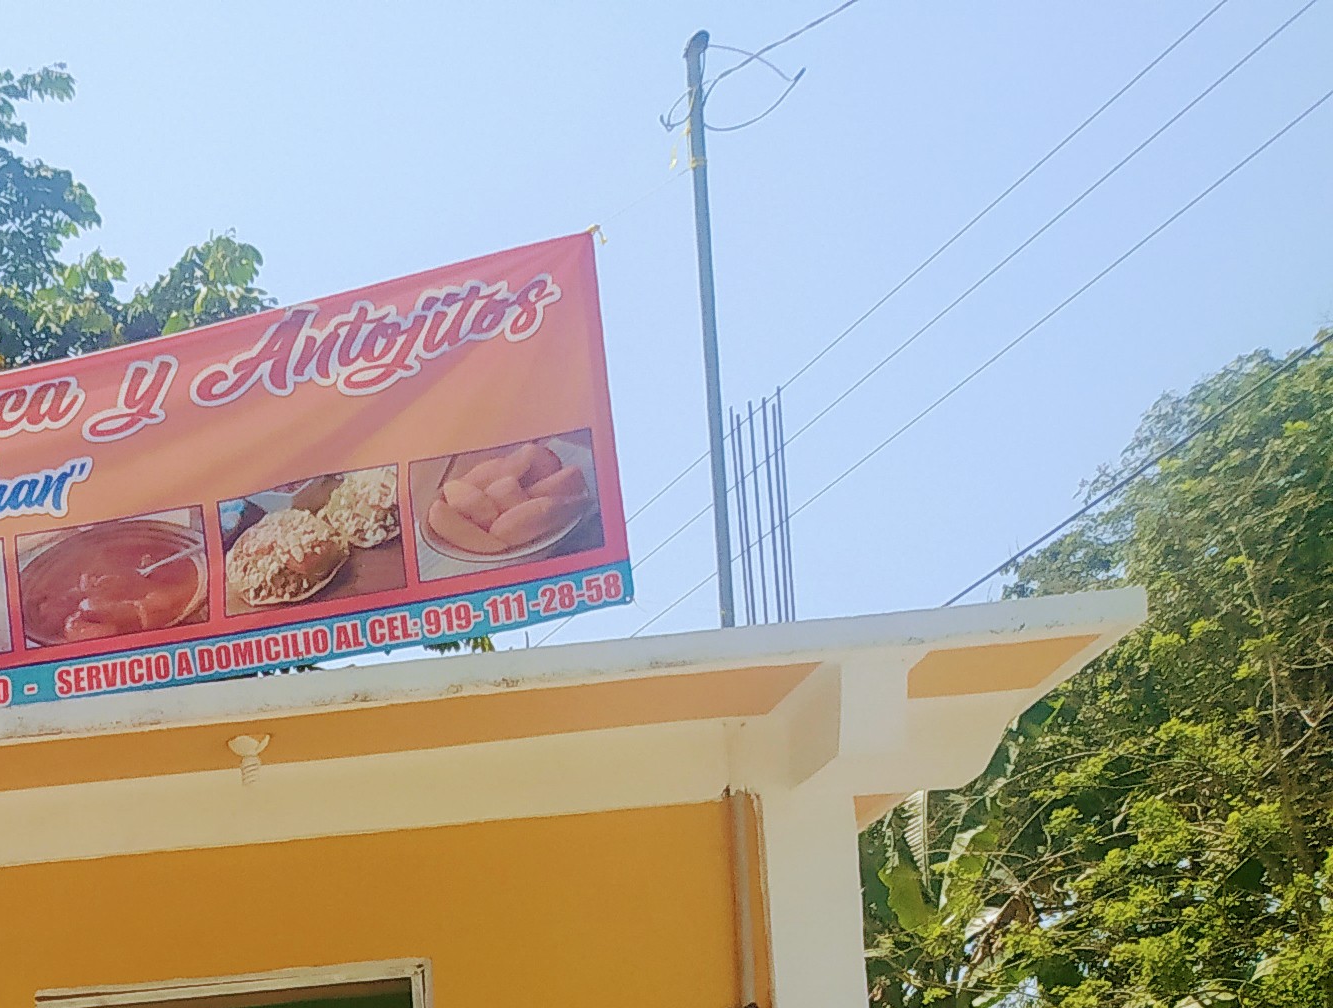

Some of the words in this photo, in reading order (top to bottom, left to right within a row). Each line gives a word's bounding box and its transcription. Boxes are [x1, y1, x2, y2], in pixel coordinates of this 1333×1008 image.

[193, 275, 559, 392] Antojitos
[56, 654, 171, 695] SERVICIO
[176, 651, 194, 677] A
[197, 627, 328, 673] DOMICILIO
[335, 622, 364, 651] AL
[368, 615, 420, 645] CEL:
